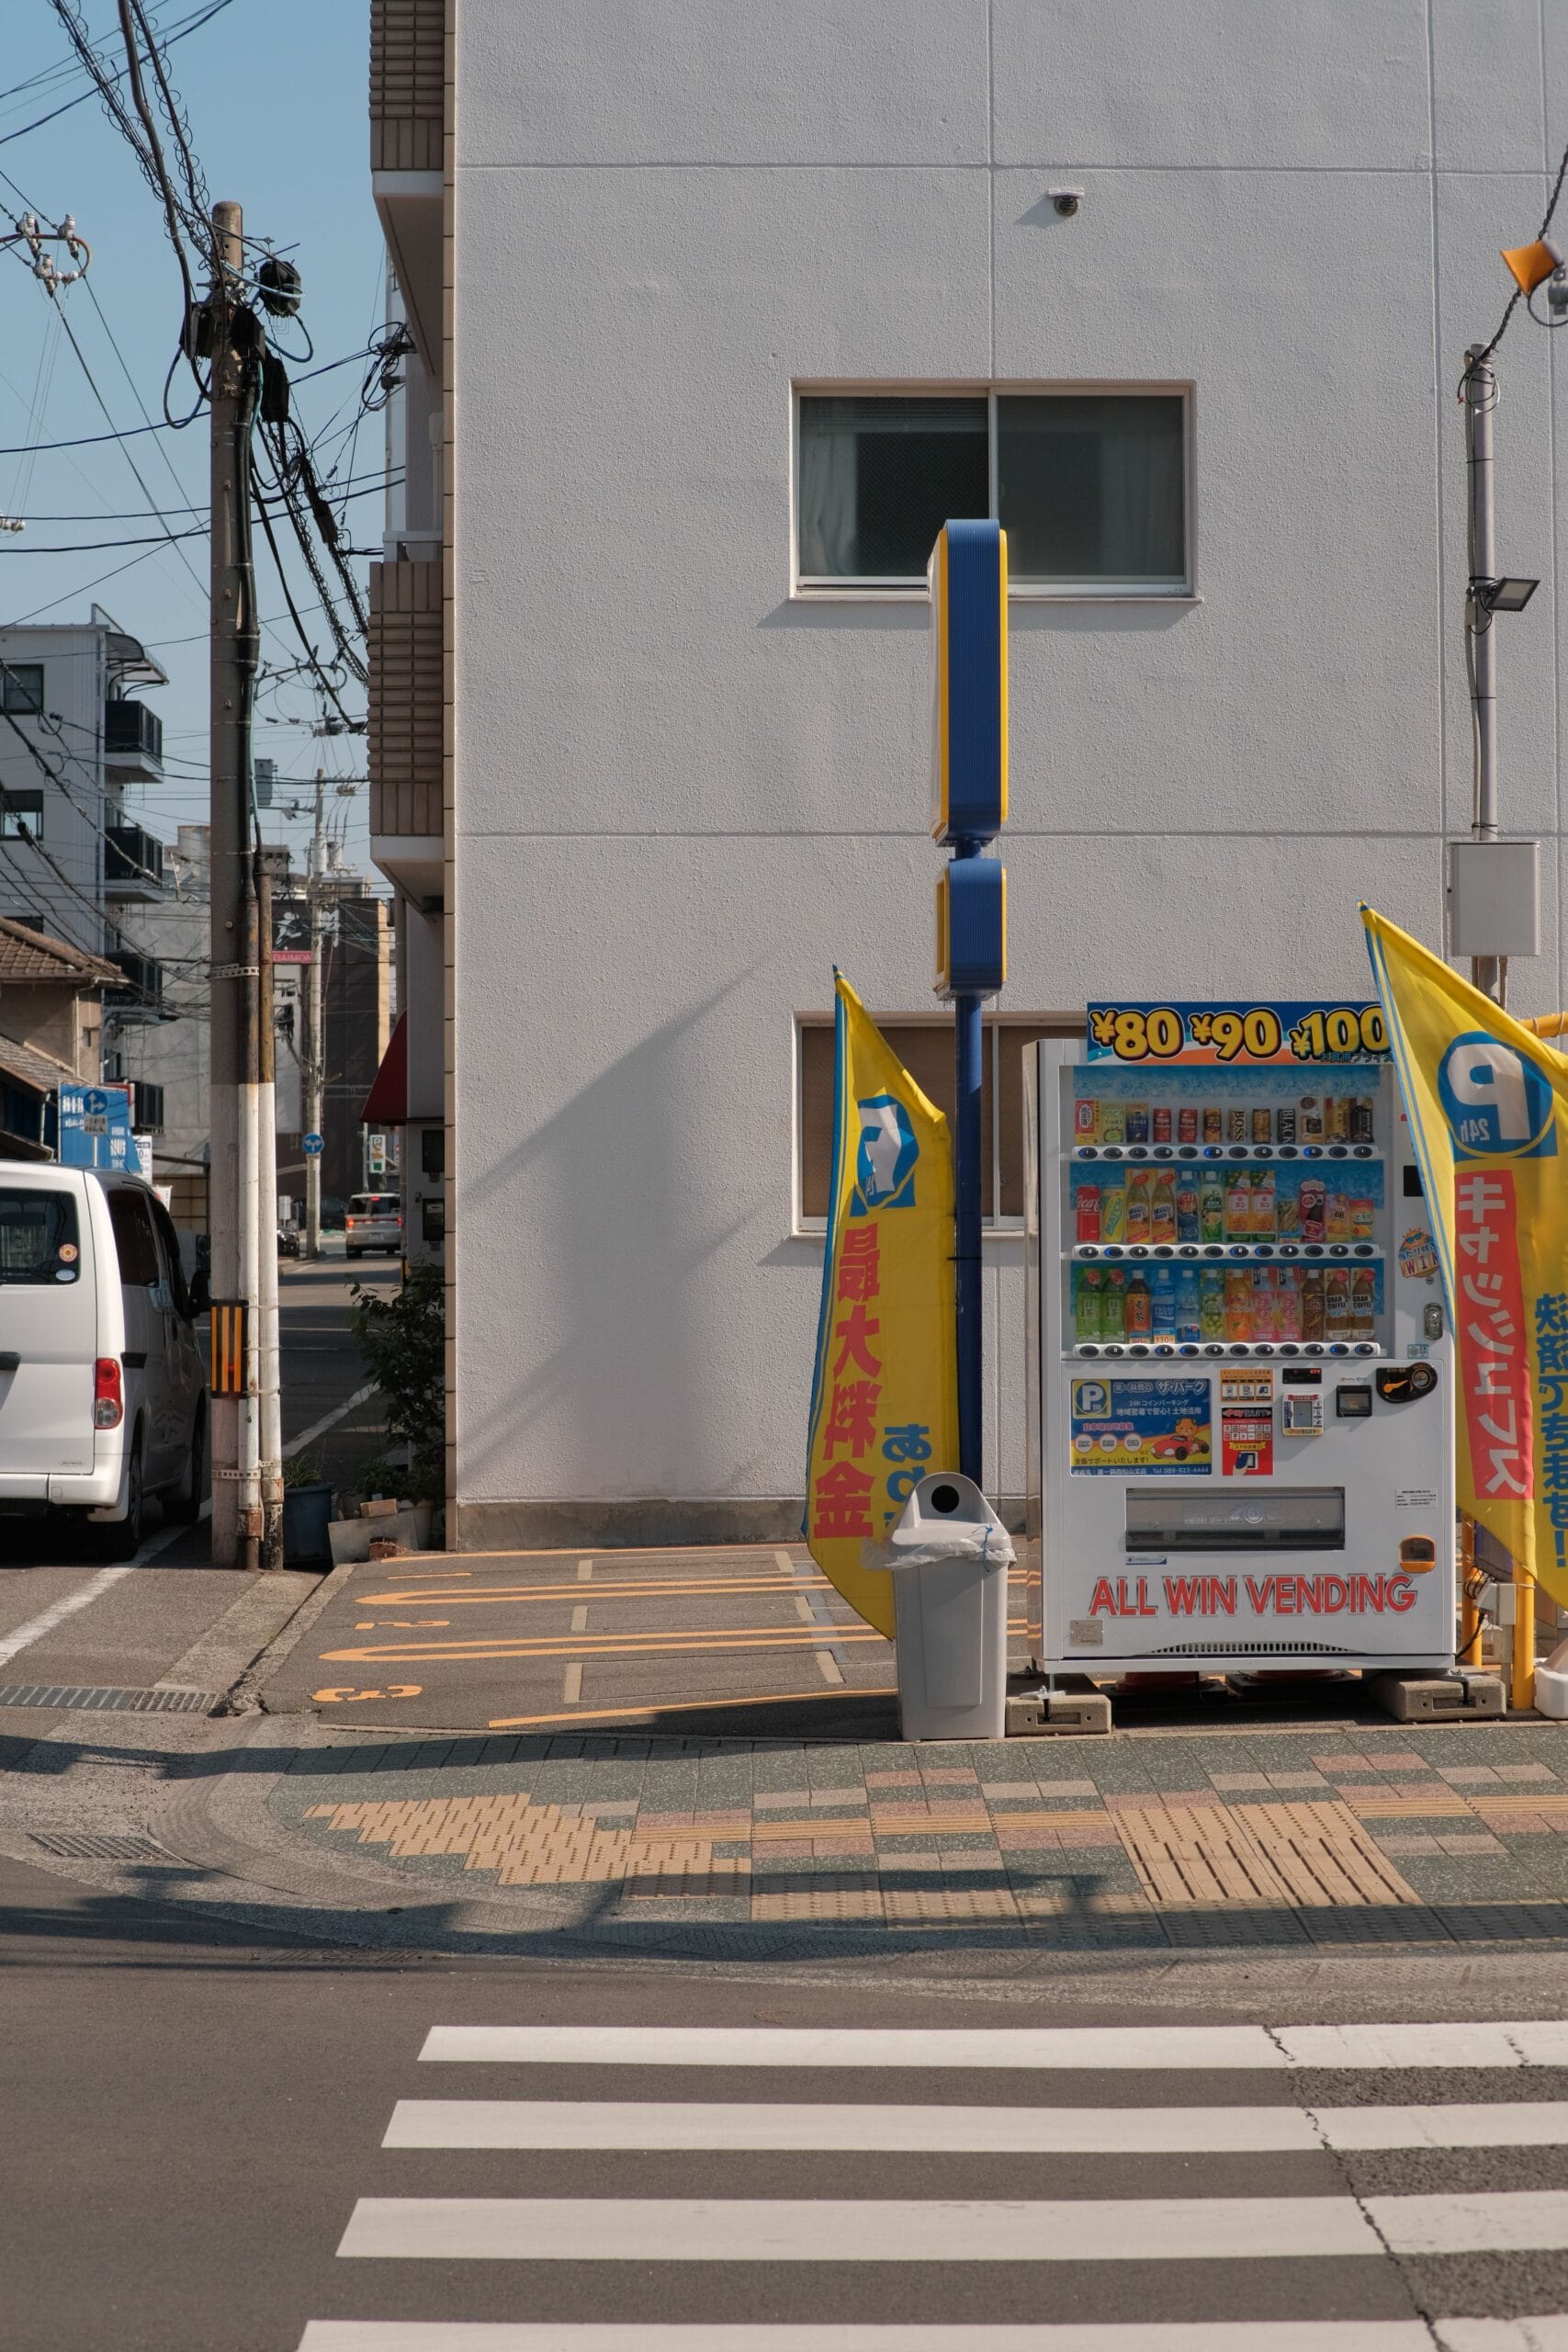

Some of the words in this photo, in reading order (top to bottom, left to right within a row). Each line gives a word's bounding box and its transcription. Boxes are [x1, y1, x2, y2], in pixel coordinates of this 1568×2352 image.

[1090, 1009, 1184, 1059] ¥80
[1190, 1009, 1280, 1061] ¥90
[1289, 1006, 1392, 1057] ¥100
[1235, 1110, 1245, 1141] BOSS
[1282, 1109, 1293, 1145] BLACK
[1081, 1385, 1104, 1412] P
[1089, 1577, 1158, 1617] ALL
[1163, 1575, 1237, 1616] WIN
[1245, 1574, 1418, 1616] VENDING
